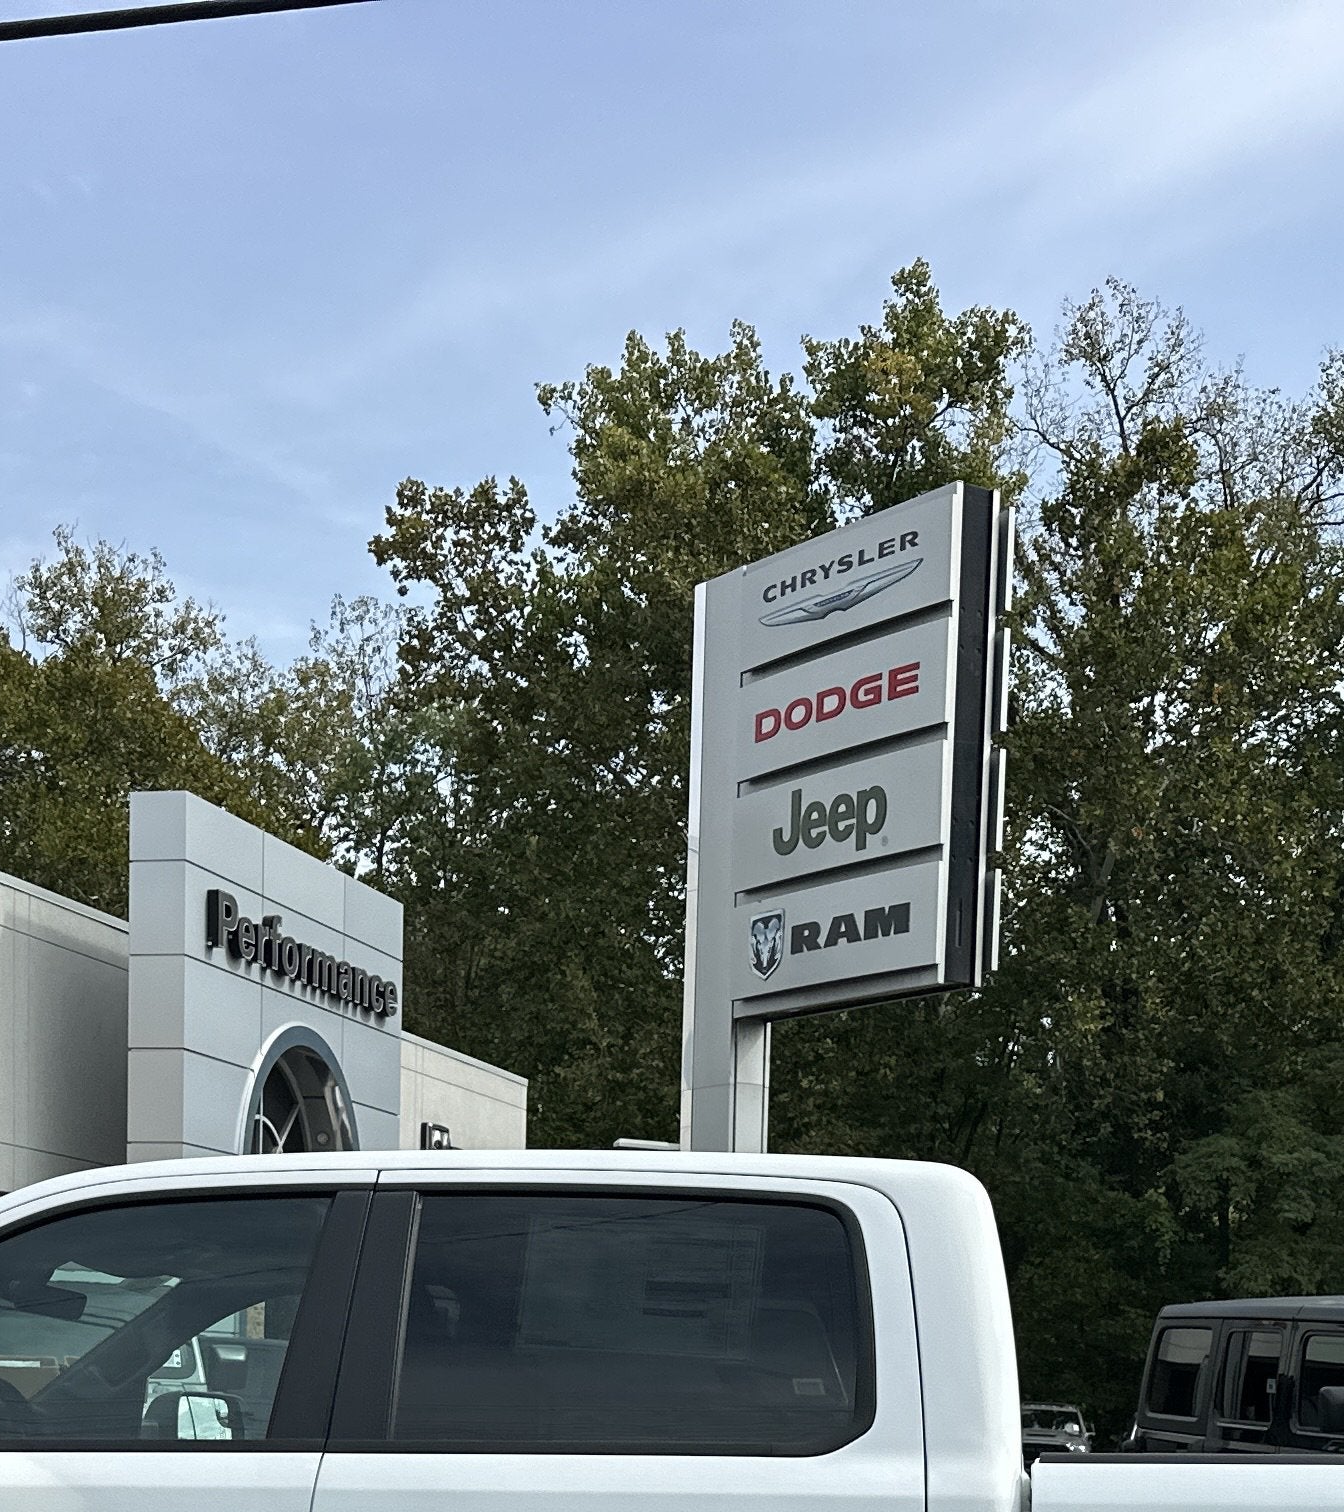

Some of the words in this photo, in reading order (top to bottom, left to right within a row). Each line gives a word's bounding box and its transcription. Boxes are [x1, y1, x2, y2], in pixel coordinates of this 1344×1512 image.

[762, 530, 919, 603] CHRYSLER
[755, 662, 920, 743] DODGE
[773, 784, 888, 857] Jeep
[207, 889, 398, 1018] Performance
[791, 902, 911, 954] RAM
